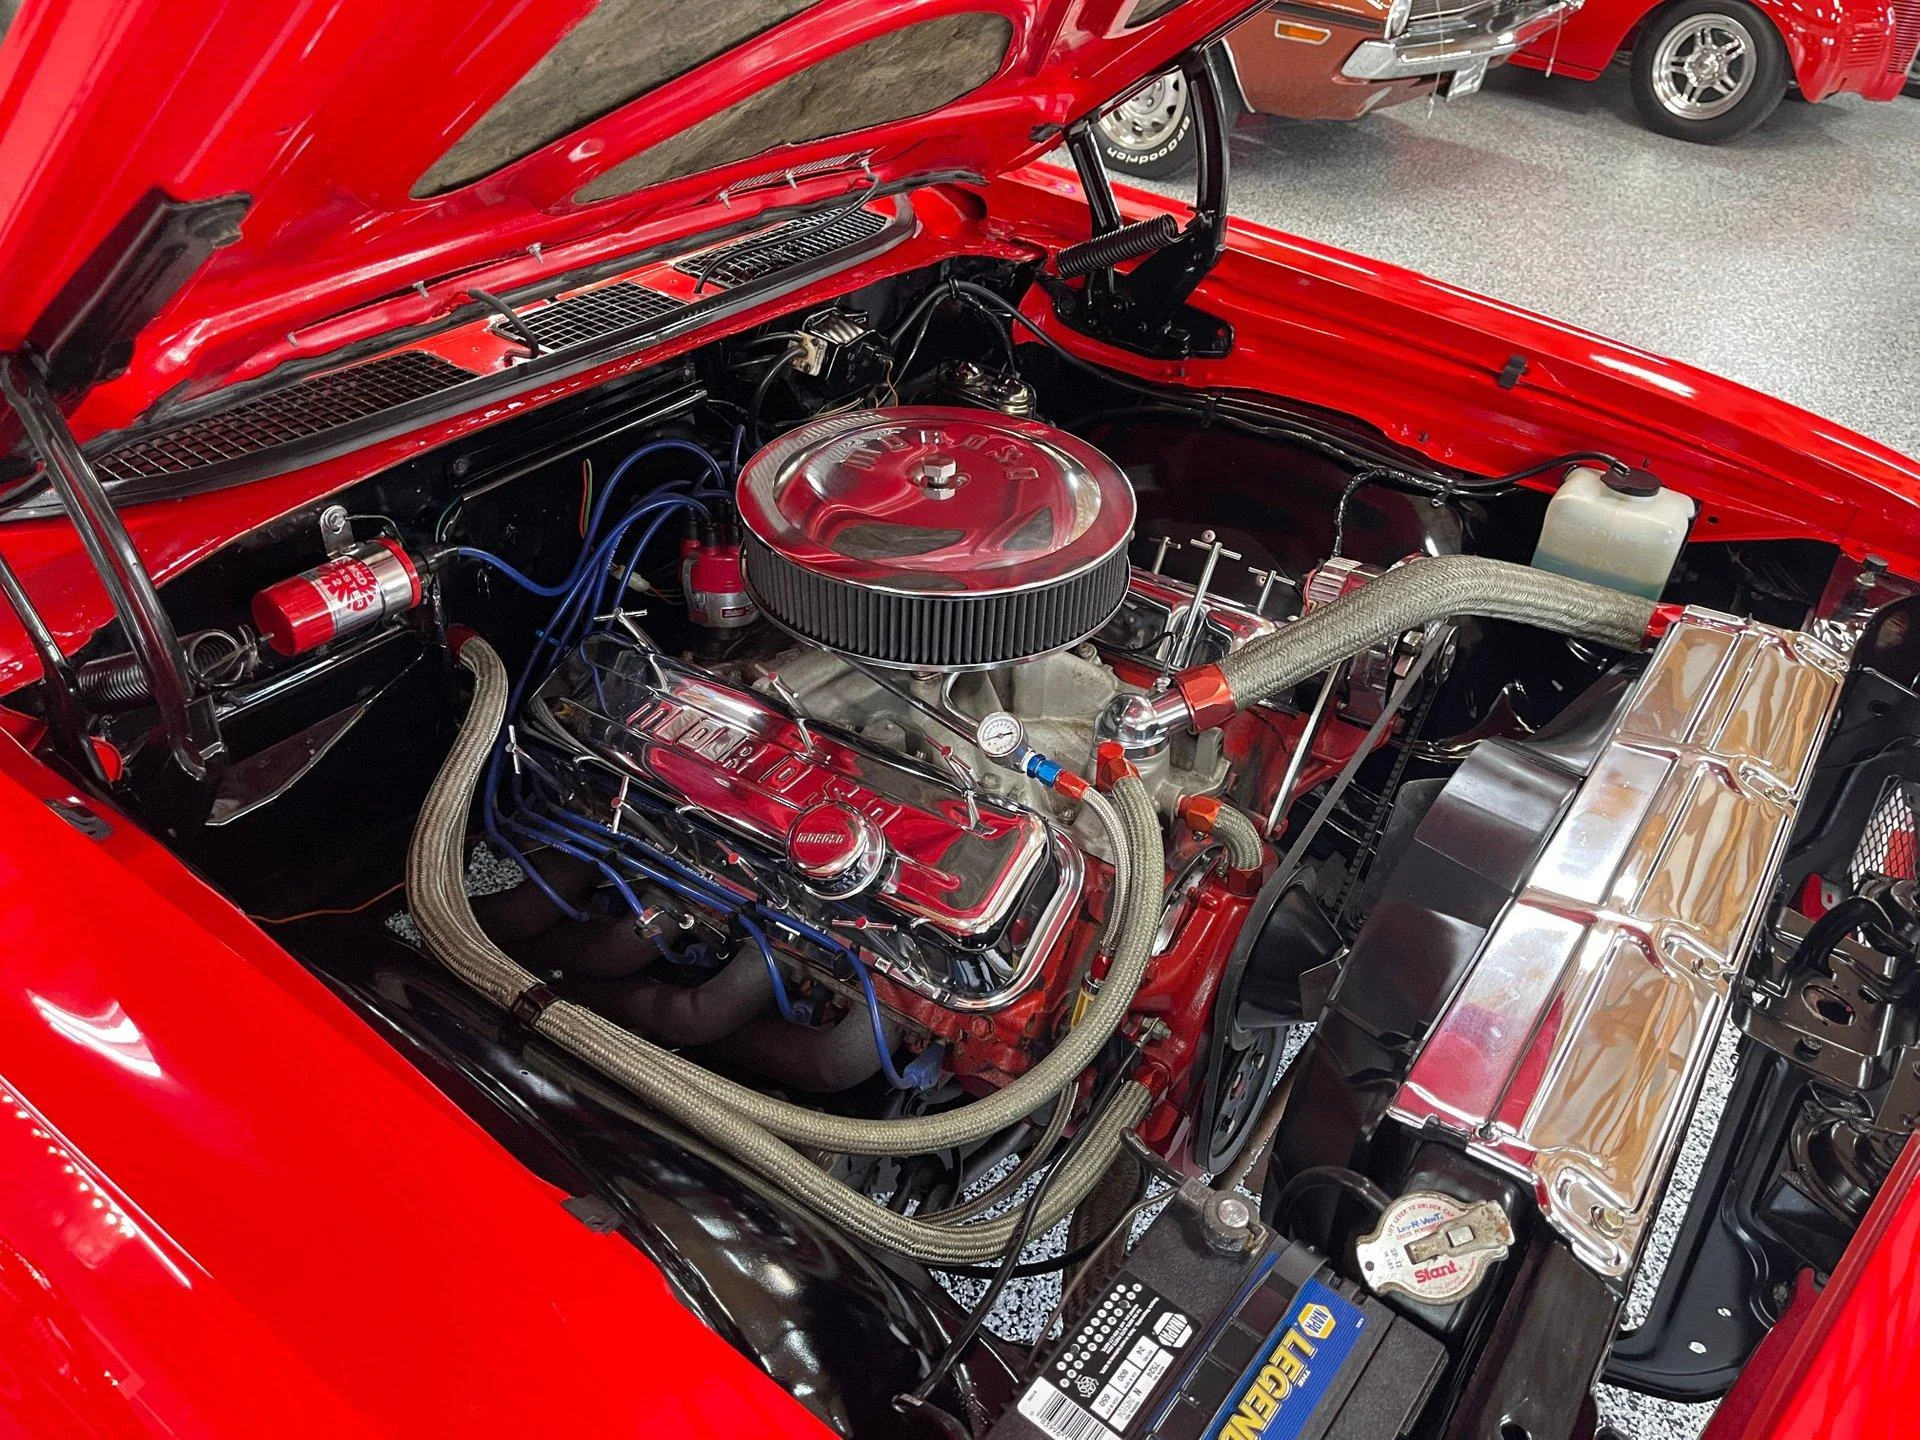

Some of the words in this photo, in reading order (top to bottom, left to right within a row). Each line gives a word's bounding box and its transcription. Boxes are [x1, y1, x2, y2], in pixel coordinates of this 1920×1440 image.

[1107, 115, 1190, 164] BFGoodrich
[331, 578, 343, 588] 2
[347, 565, 368, 586] MSD
[1418, 1203, 1441, 1211] UNLOCK
[1414, 1259, 1458, 1284] Stant
[1159, 1314, 1188, 1344] NAPA
[1304, 1307, 1329, 1334] NAPA
[1136, 1346, 1146, 1356] 24
[1117, 1368, 1129, 1382] 800
[1146, 1362, 1160, 1378] 7524
[1297, 1370, 1311, 1388] THE
[1098, 1393, 1111, 1407] 650
